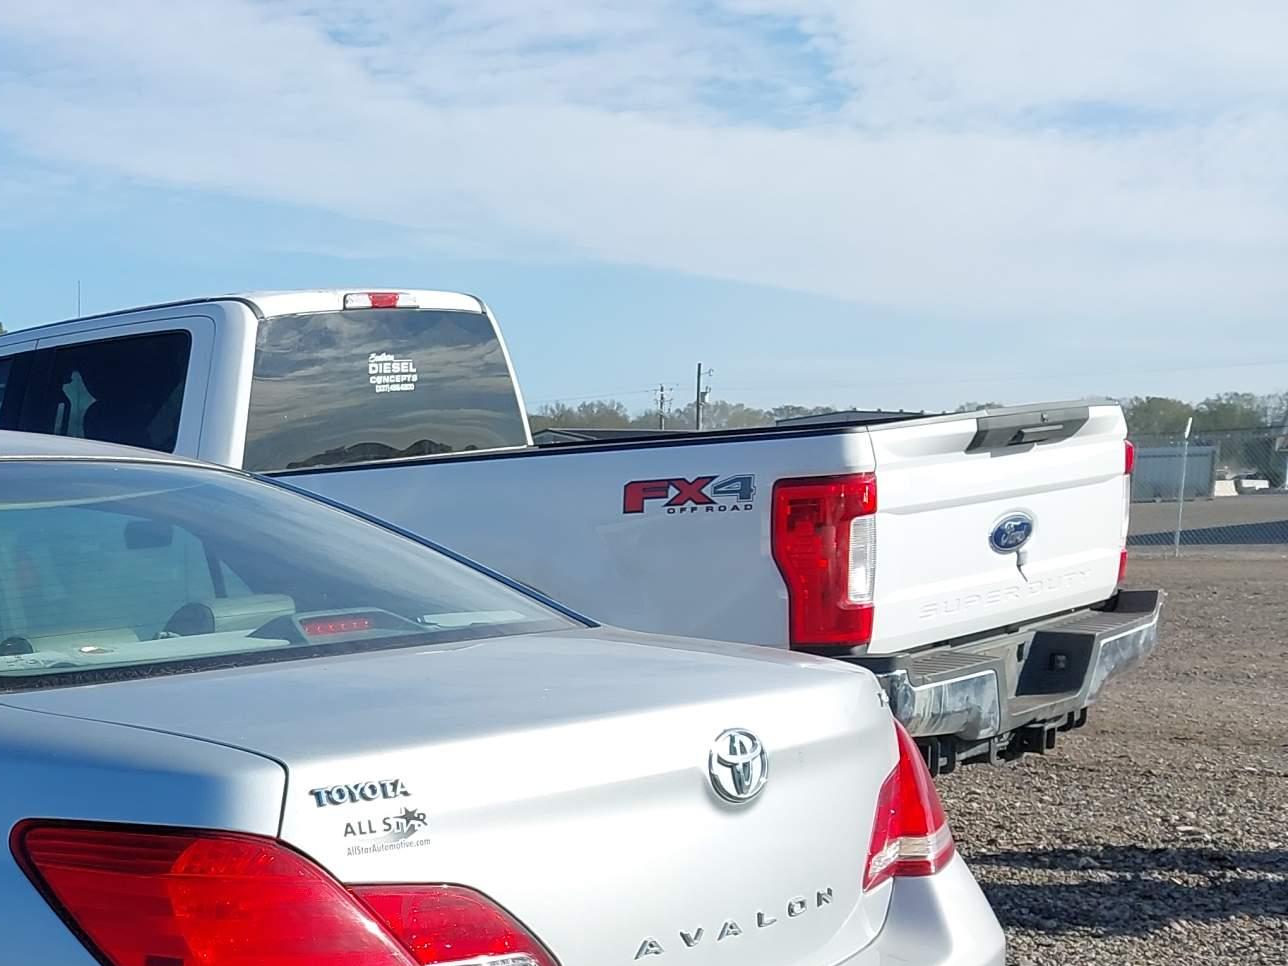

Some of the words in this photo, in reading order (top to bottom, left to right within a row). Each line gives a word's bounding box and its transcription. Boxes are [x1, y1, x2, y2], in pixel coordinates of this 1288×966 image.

[368, 362, 417, 375] DIESEL
[369, 374, 418, 385] CONCEPTS
[622, 474, 756, 515] FX4
[705, 504, 753, 512] ROAD
[919, 585, 1020, 619] SUPER
[1025, 569, 1093, 596] DUTY
[308, 779, 411, 808] TOYOTA
[344, 819, 377, 837] ALL
[346, 838, 431, 857] AllStarAutomotive.com
[634, 888, 834, 959] AVALON
